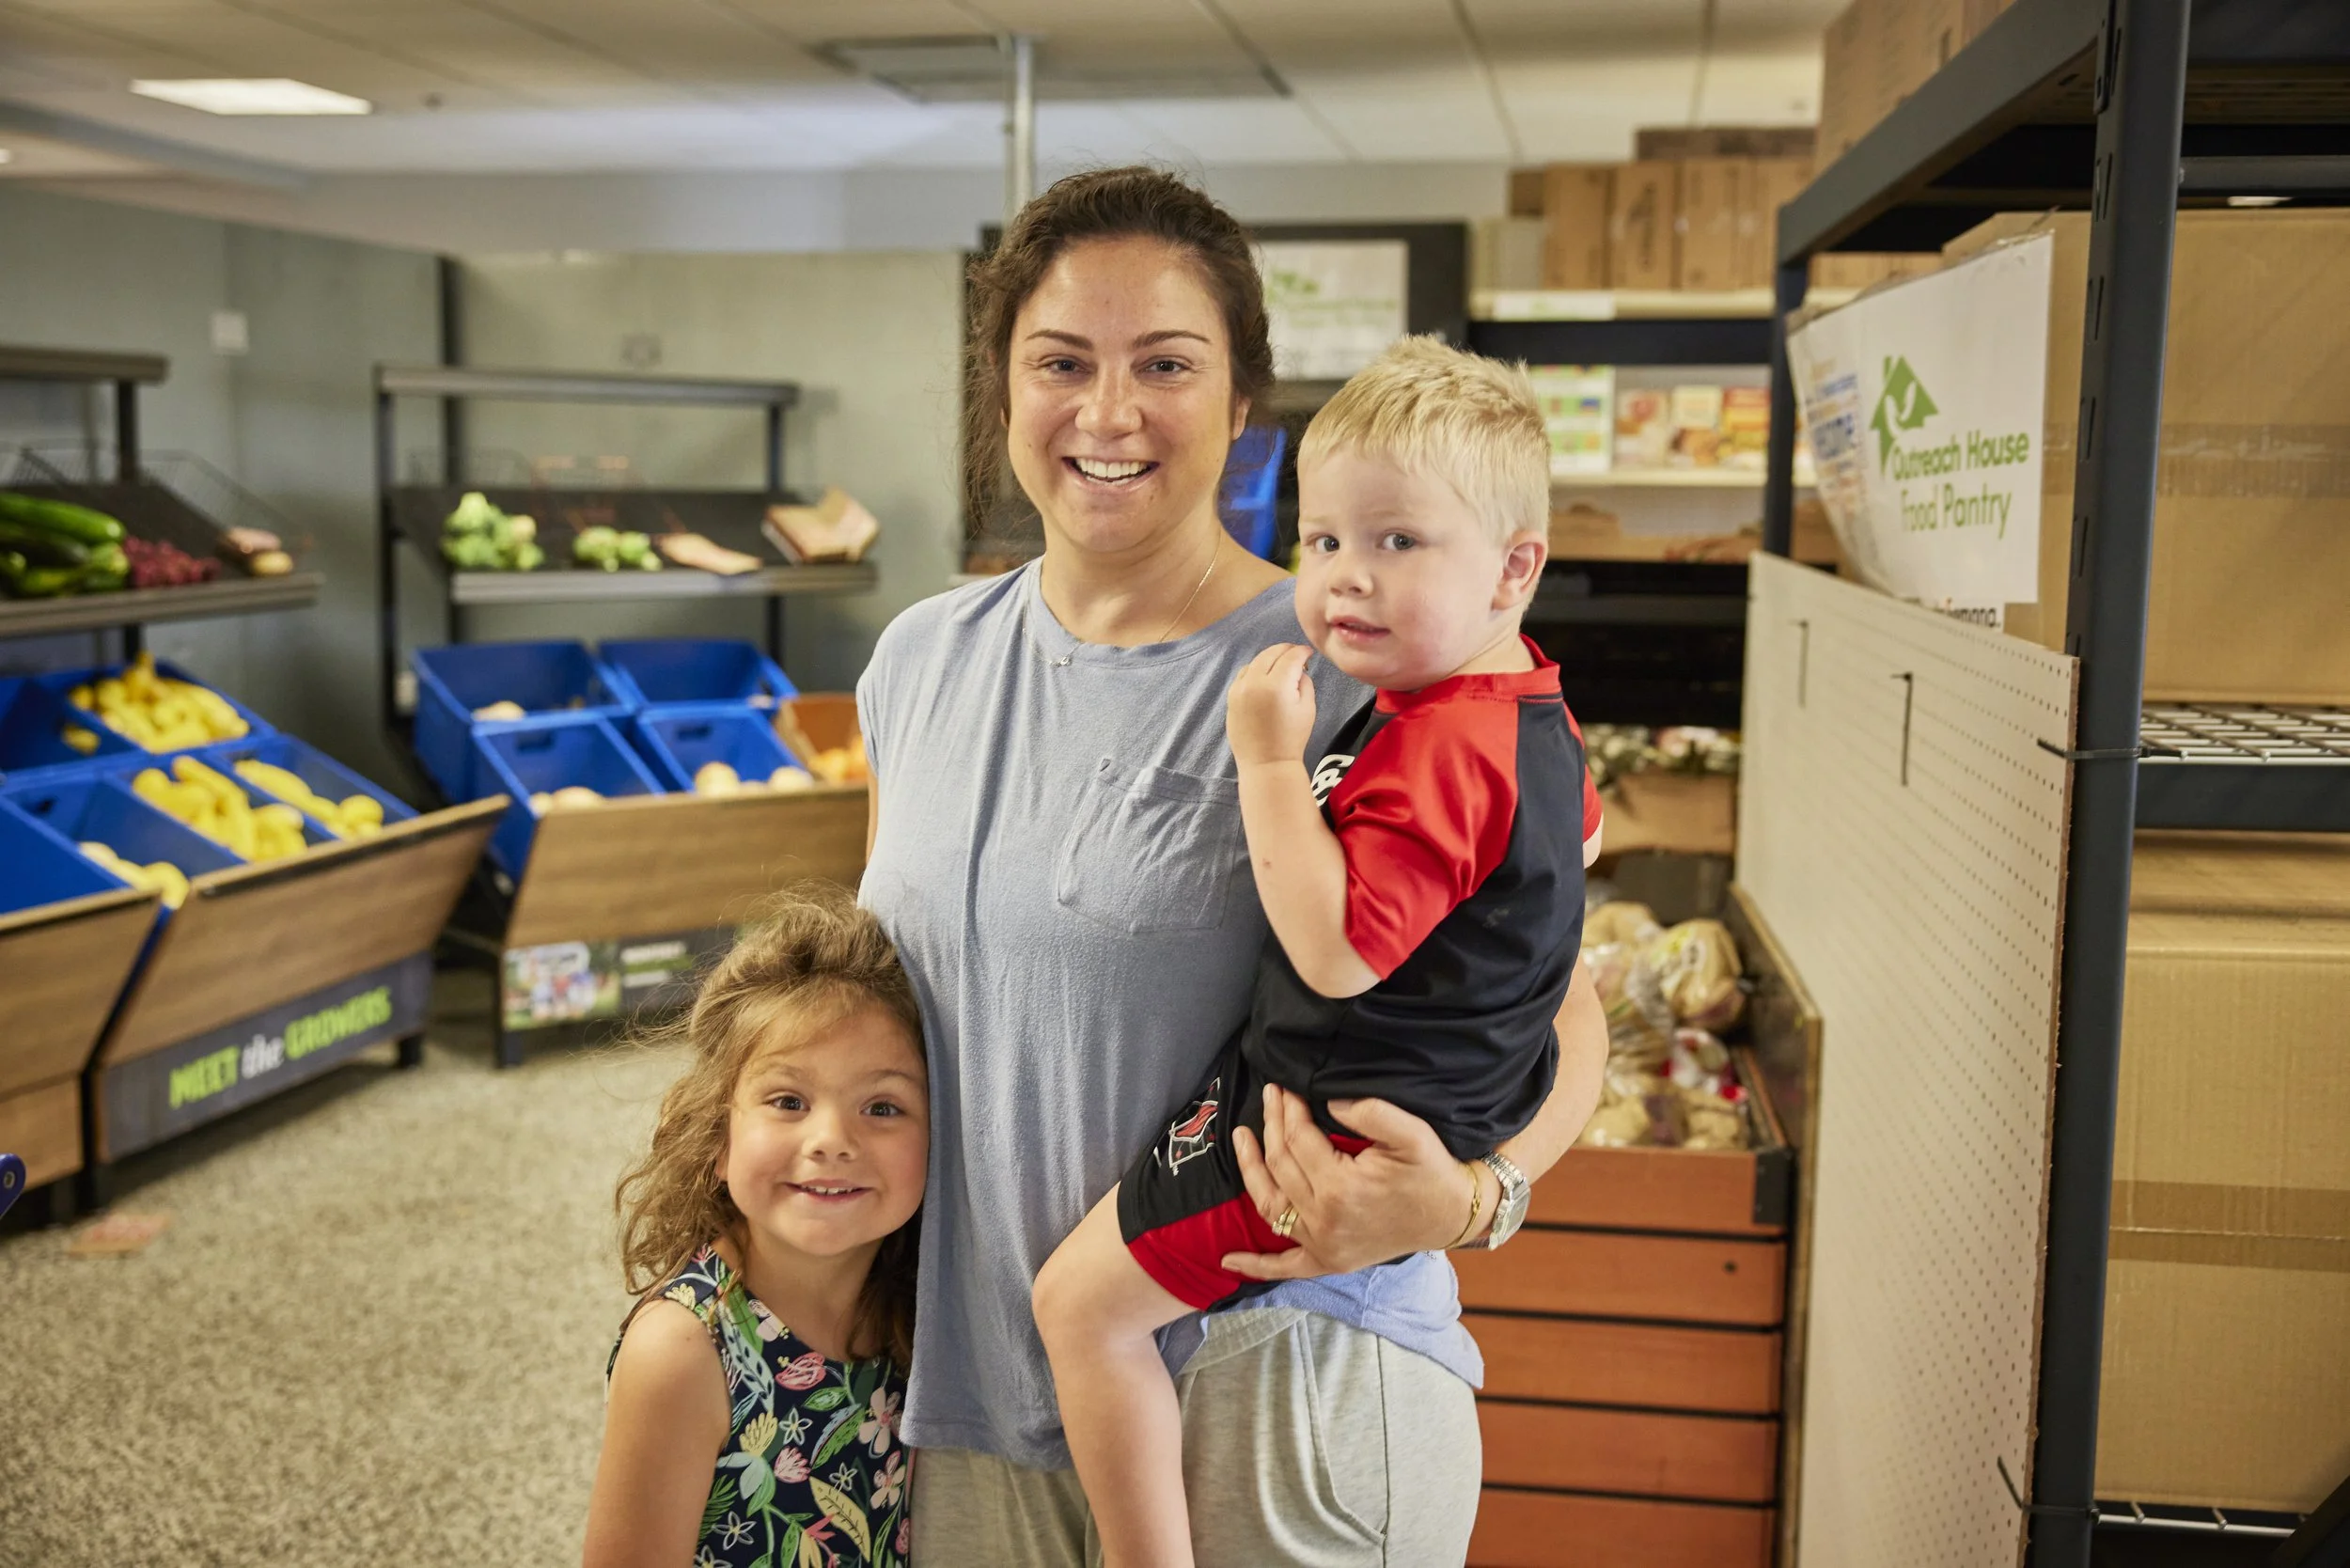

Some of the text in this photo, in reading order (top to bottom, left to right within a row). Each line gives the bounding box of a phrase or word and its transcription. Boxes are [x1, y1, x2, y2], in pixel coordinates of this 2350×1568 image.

[1892, 433, 1961, 481] Outreach
[1966, 429, 2030, 470] House
[1901, 481, 2013, 541] Food Pantry
[169, 985, 393, 1110] MEET the GROWERS
